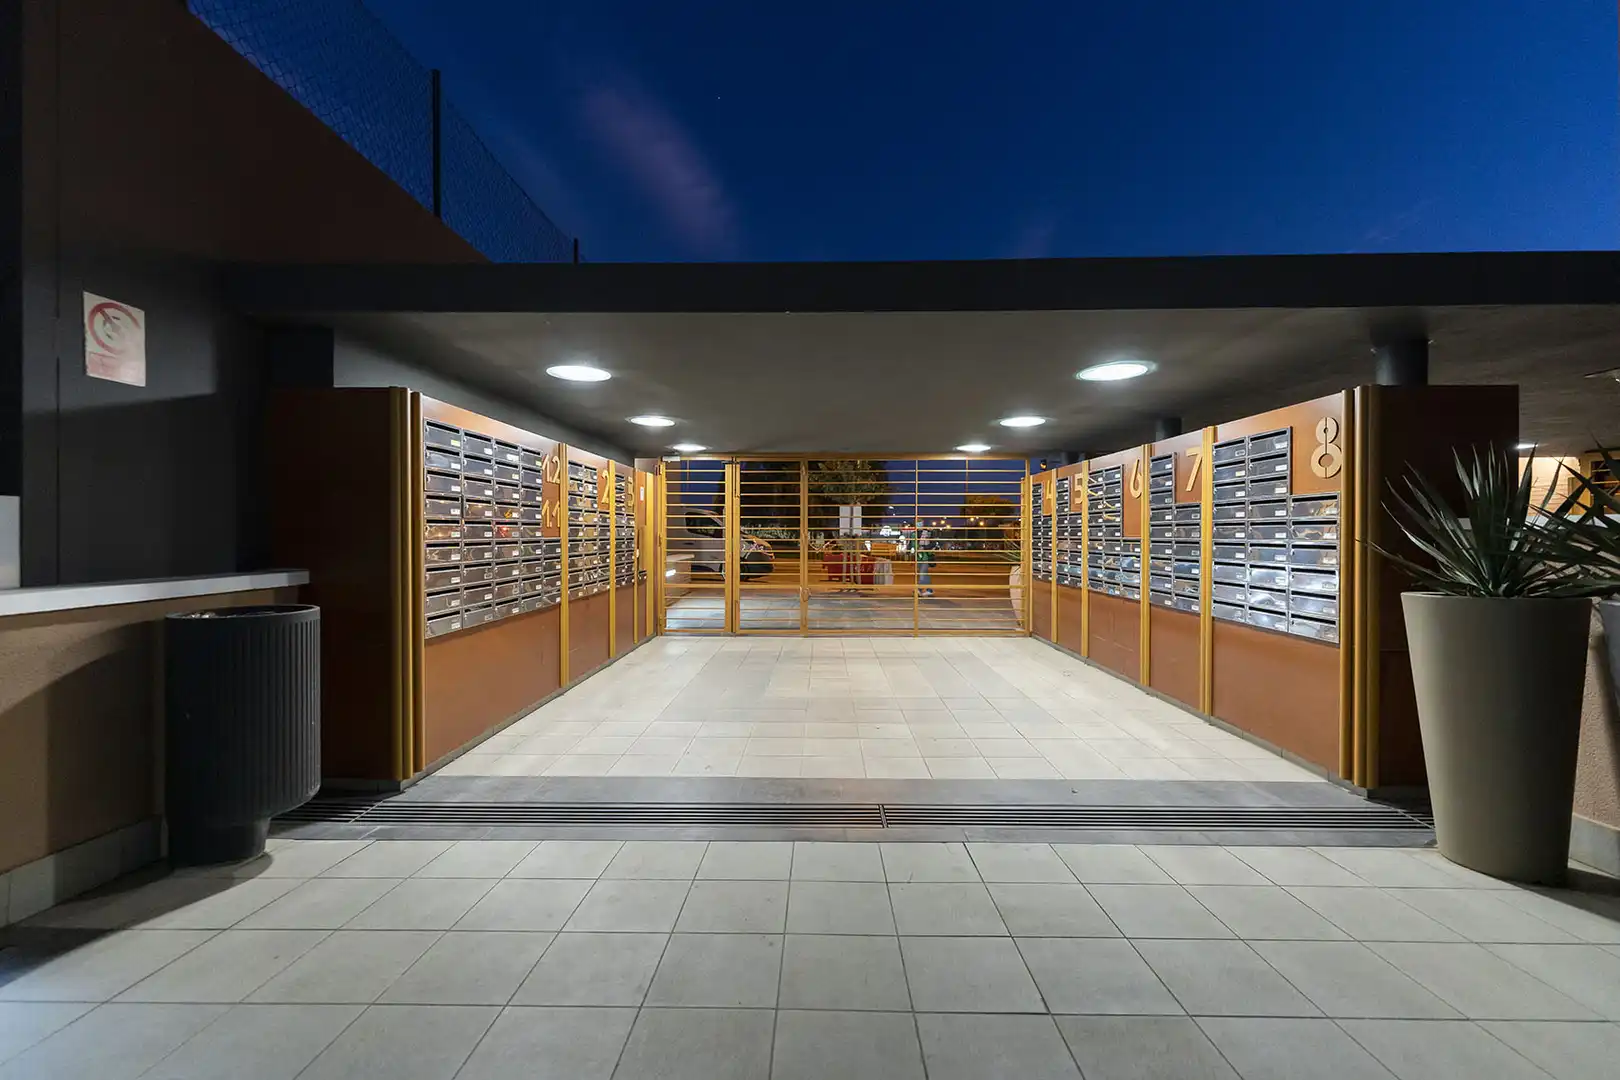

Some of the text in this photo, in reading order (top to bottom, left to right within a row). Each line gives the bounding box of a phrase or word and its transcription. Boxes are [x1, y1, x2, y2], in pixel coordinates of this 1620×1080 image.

[1310, 416, 1343, 479] 8
[541, 453, 561, 485] 12
[1185, 446, 1204, 492] 7
[541, 499, 561, 528] 11
